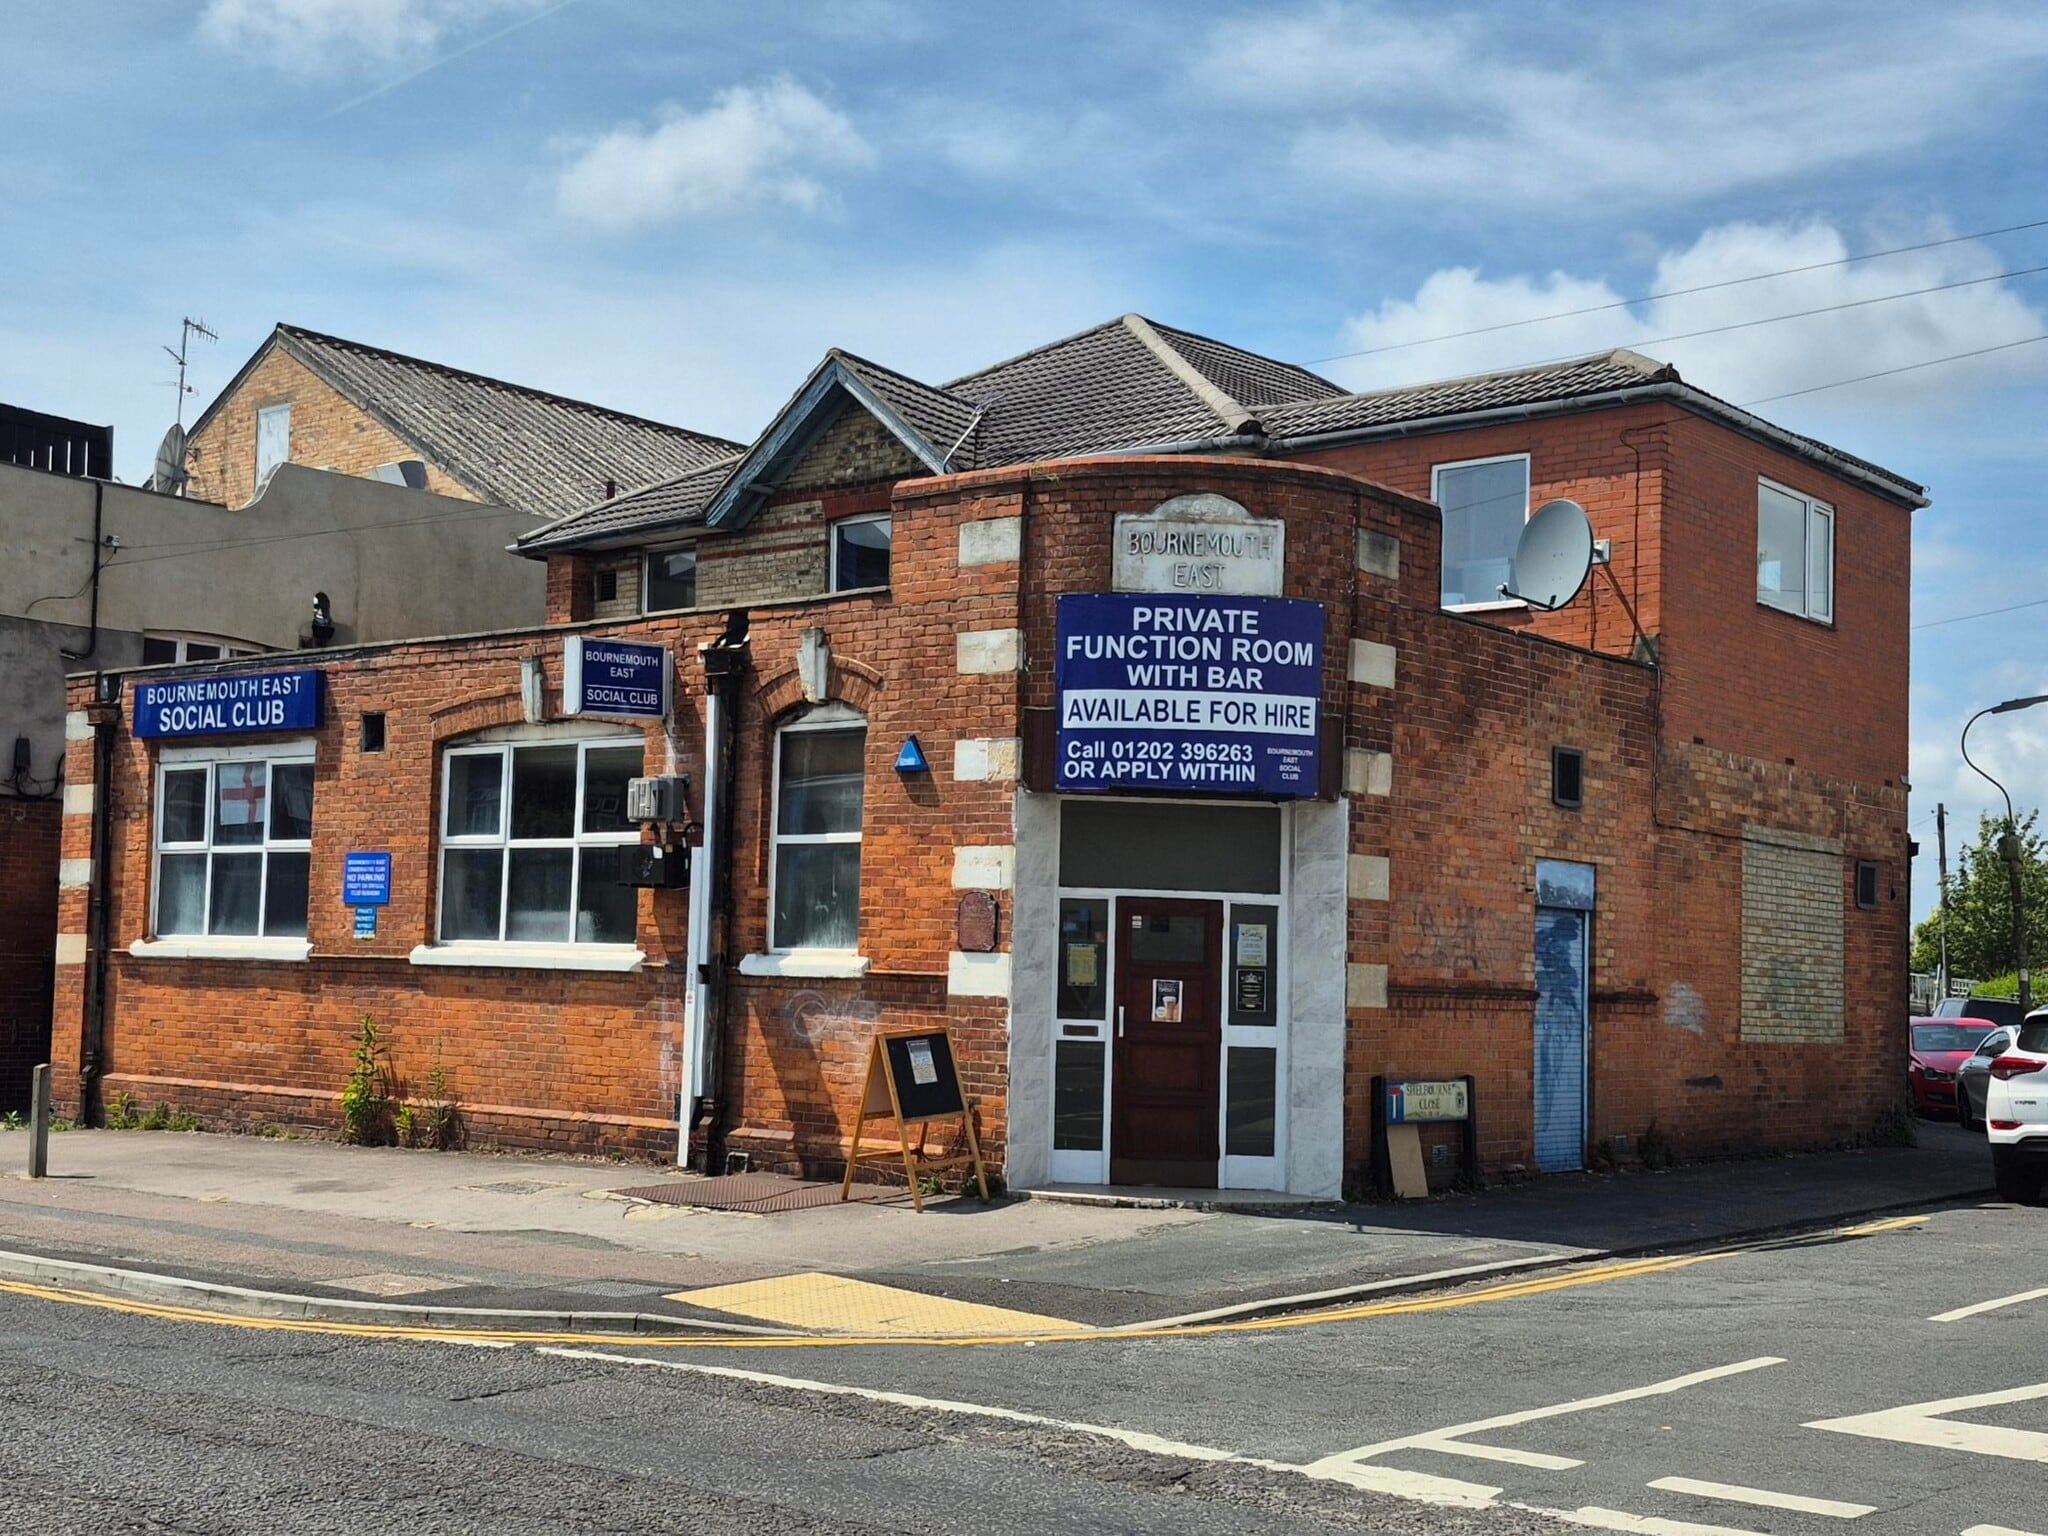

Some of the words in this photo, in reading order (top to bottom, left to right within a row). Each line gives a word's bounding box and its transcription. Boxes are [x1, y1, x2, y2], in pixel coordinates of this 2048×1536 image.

[1127, 530, 1273, 560] BOURNEMOUTH
[1173, 562, 1226, 588] EAST
[1132, 606, 1259, 635] PRIVATE
[585, 651, 658, 667] BOURNEMOUTH
[1066, 635, 1223, 661] FUNCTION
[1231, 638, 1314, 667] ROOM
[610, 667, 635, 678] EAST
[1126, 664, 1199, 688] WITH
[1207, 666, 1264, 690] BAR
[147, 679, 258, 705] BOURNEMOUTH
[262, 675, 302, 696] EAST
[587, 689, 627, 702] SOCIAL
[629, 692, 658, 705] CLUB
[159, 703, 227, 733] SOCIAL
[232, 699, 285, 727] CLUB
[1067, 697, 1201, 724] AVAILABLE
[1209, 700, 1258, 727] FOR
[1264, 703, 1311, 729] HIRE
[1067, 740, 1106, 760] Call
[1111, 741, 1174, 761] 01202
[1180, 743, 1254, 763] 396263
[1267, 748, 1314, 756] BOURNEMOUTH
[1282, 756, 1299, 764] EAST
[1063, 760, 1096, 779] OR
[1100, 761, 1173, 781] APPLY
[1178, 762, 1256, 782] WITHIN
[1279, 764, 1302, 772] SOCIAL
[1281, 772, 1299, 781] CLUB
[347, 873, 356, 881] NO
[1419, 1098, 1441, 1109] CLOSE
